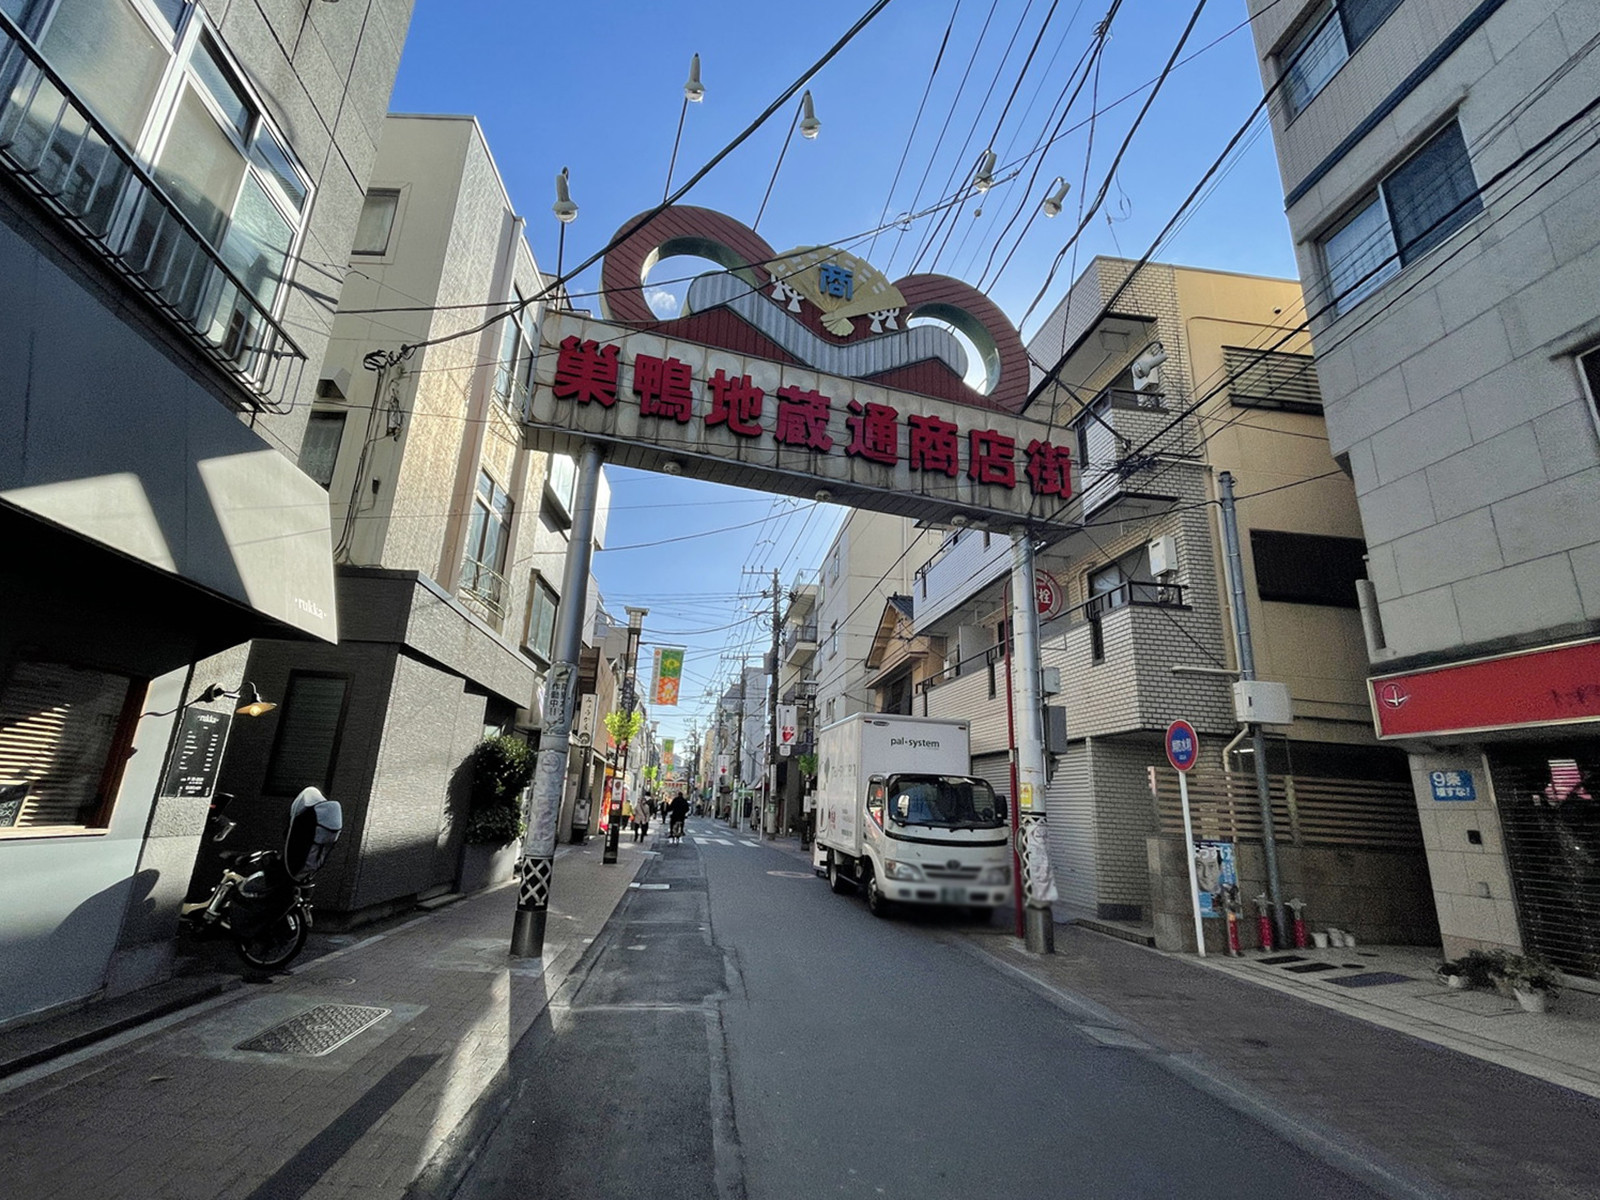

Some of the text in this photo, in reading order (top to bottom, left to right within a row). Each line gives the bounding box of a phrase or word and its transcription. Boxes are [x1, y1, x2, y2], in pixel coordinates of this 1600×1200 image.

[819, 263, 854, 301] 商
[552, 335, 1072, 500] 巣鴨地蔵通商店街
